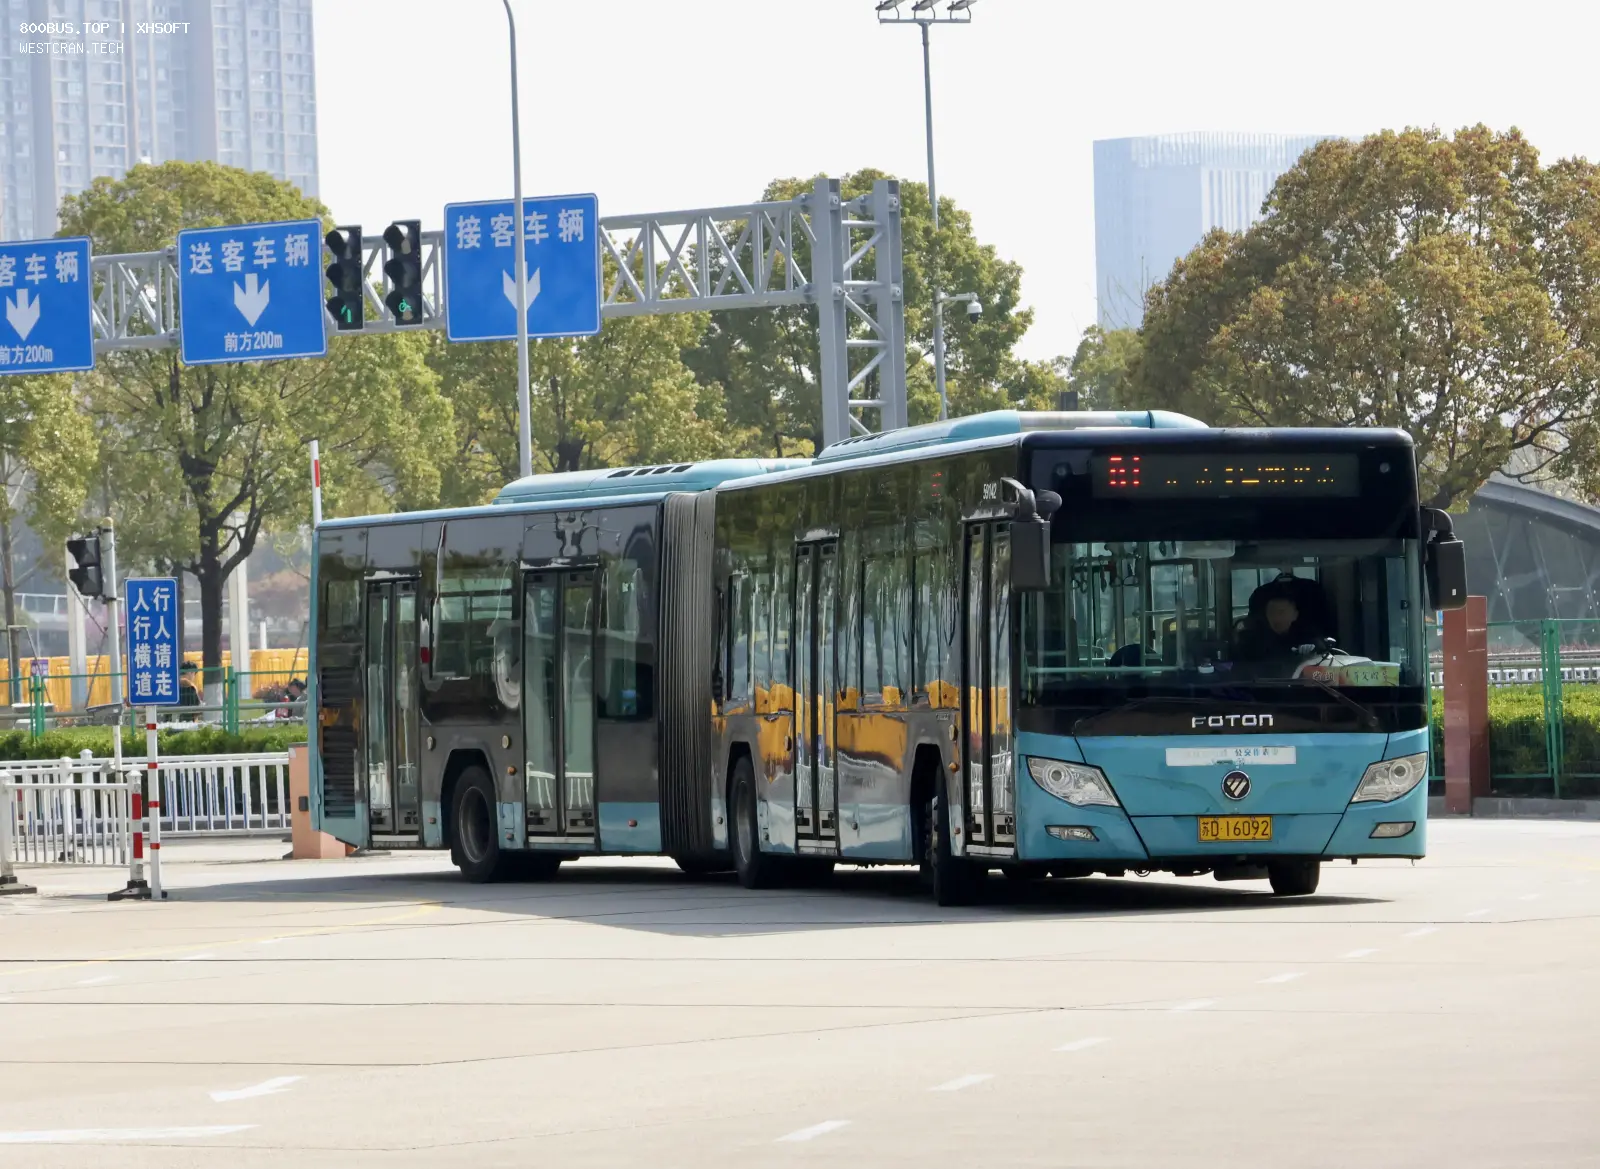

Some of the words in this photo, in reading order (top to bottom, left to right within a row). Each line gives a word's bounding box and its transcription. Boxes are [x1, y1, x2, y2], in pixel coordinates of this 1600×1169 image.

[456, 209, 584, 249] 接客车辆
[189, 233, 309, 275] 送客车辆
[224, 331, 283, 353] 前方200m
[132, 588, 152, 697] 人行横道
[153, 586, 172, 696] 行人请走
[1191, 714, 1274, 729] FOTON
